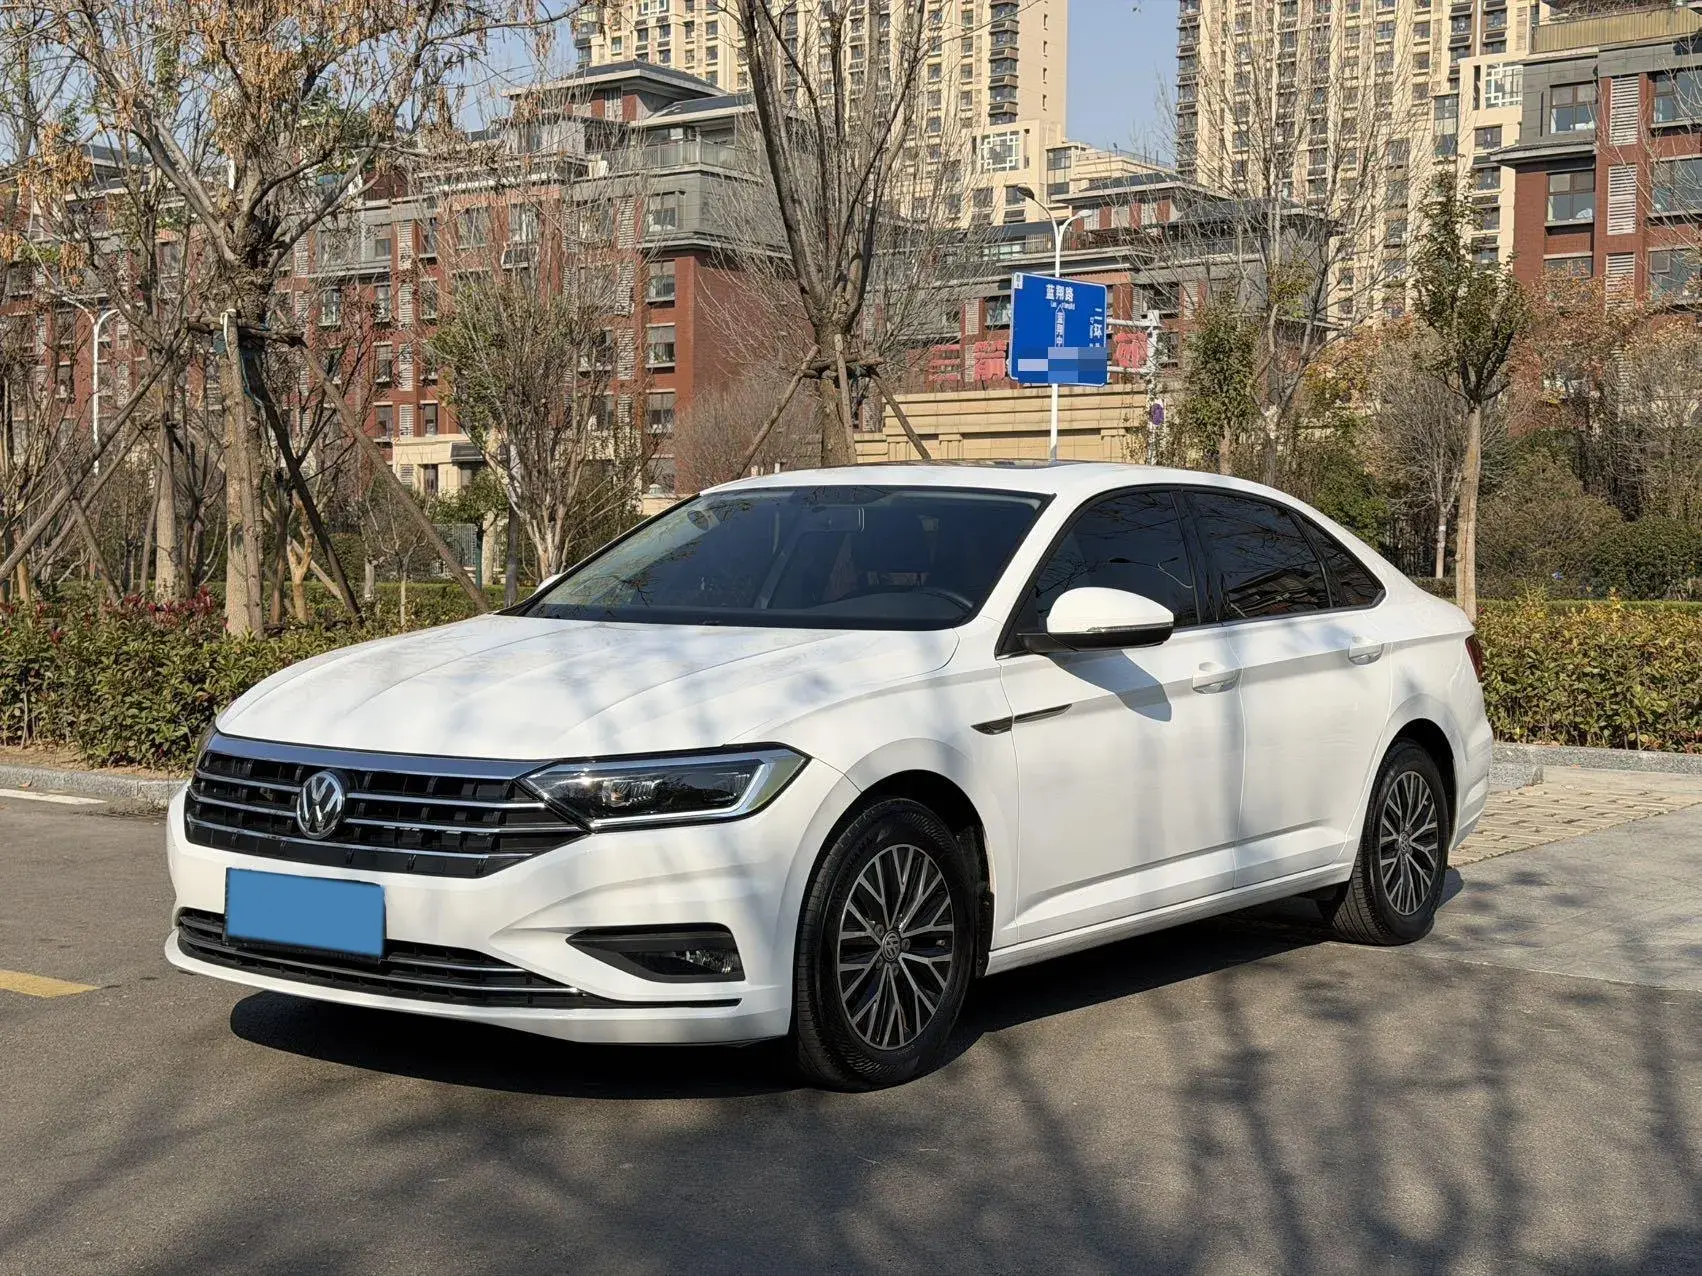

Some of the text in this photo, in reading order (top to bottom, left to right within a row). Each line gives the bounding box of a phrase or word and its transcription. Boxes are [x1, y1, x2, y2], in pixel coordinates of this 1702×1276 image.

[1045, 284, 1074, 302] 蓝翔路
[1094, 308, 1103, 347] 二环
